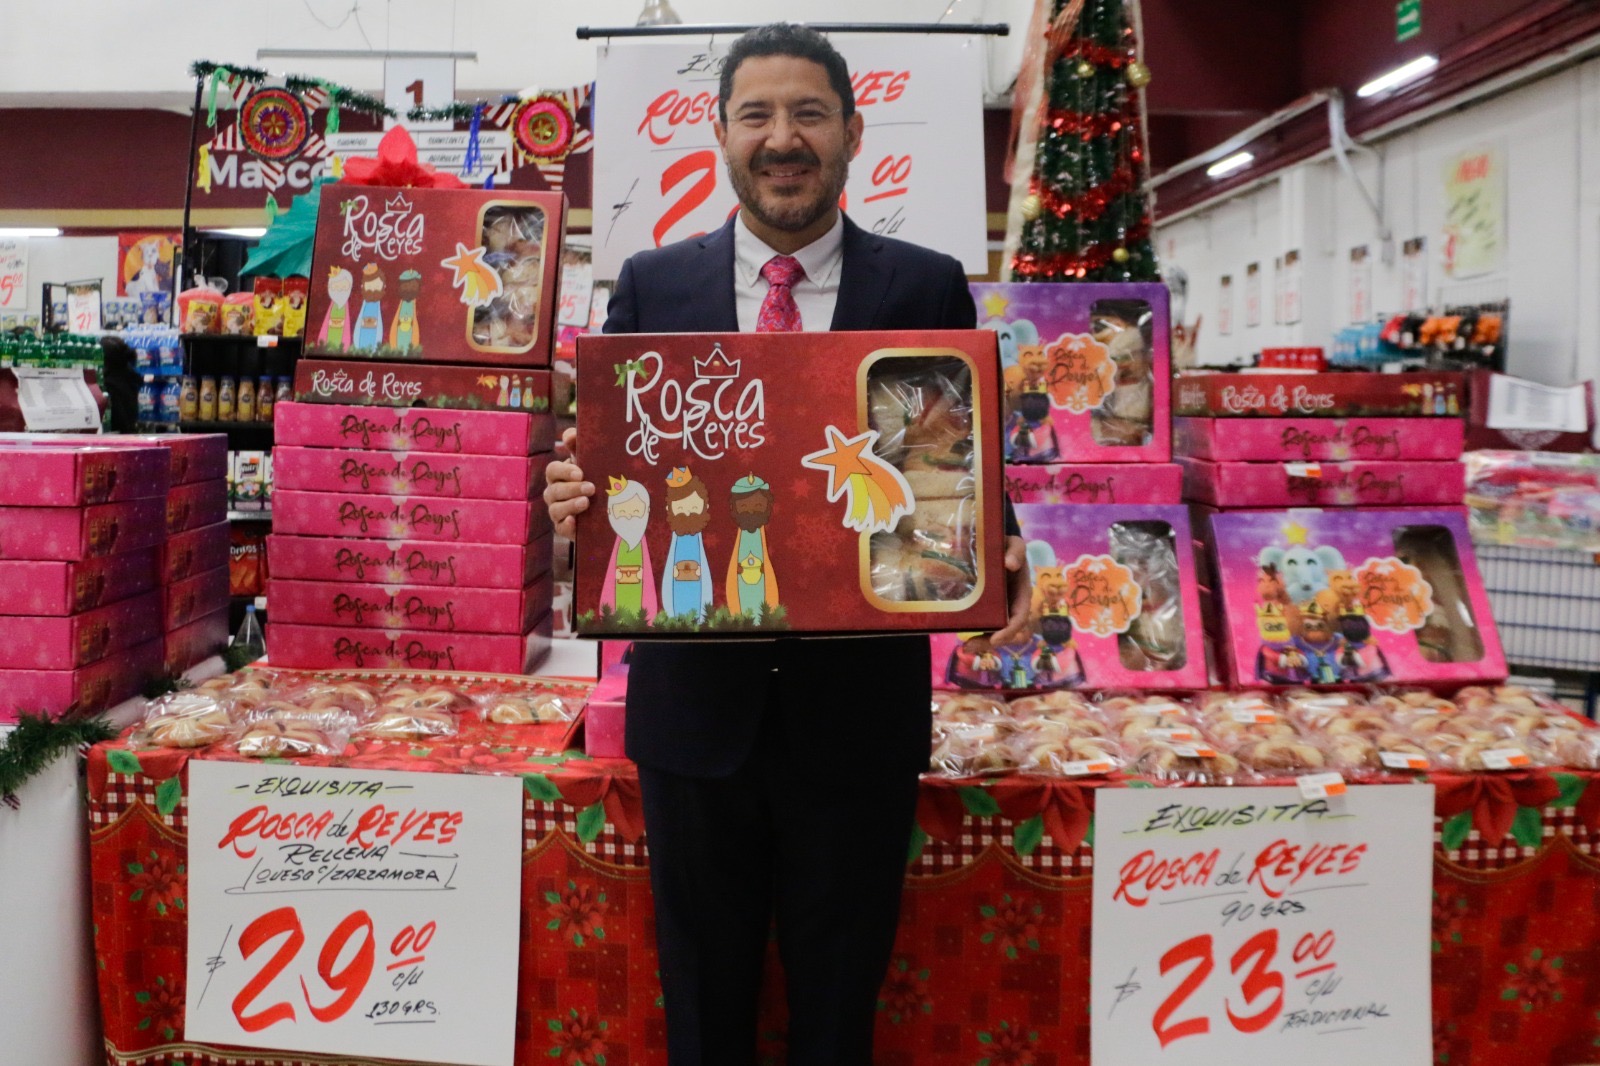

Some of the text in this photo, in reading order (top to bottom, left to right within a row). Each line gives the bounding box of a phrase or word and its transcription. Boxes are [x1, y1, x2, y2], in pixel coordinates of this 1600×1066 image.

[405, 79, 423, 107] 1
[638, 71, 911, 145] ROSC YES
[872, 154, 912, 187] 00
[343, 194, 424, 247] Rosca
[341, 230, 423, 261] de Reyes
[312, 369, 422, 400] Rosca de Reyes
[626, 351, 764, 439] Rosca
[1221, 385, 1266, 413] Rosca
[1270, 385, 1288, 412] de
[1293, 385, 1335, 414] Reyes
[625, 406, 766, 466] de Reyes
[1005, 475, 1041, 503] osca
[255, 777, 384, 797] EXQUISITA
[218, 804, 463, 858] ROSCA de REYES
[1145, 800, 1330, 832] EXQUISITA
[279, 844, 389, 866] RELLENA
[1113, 839, 1369, 907] ROSCA de REYES
[231, 906, 376, 1033] 29
[390, 920, 437, 957] 00
[1152, 927, 1284, 1050] 23
[1292, 930, 1336, 964] 00
